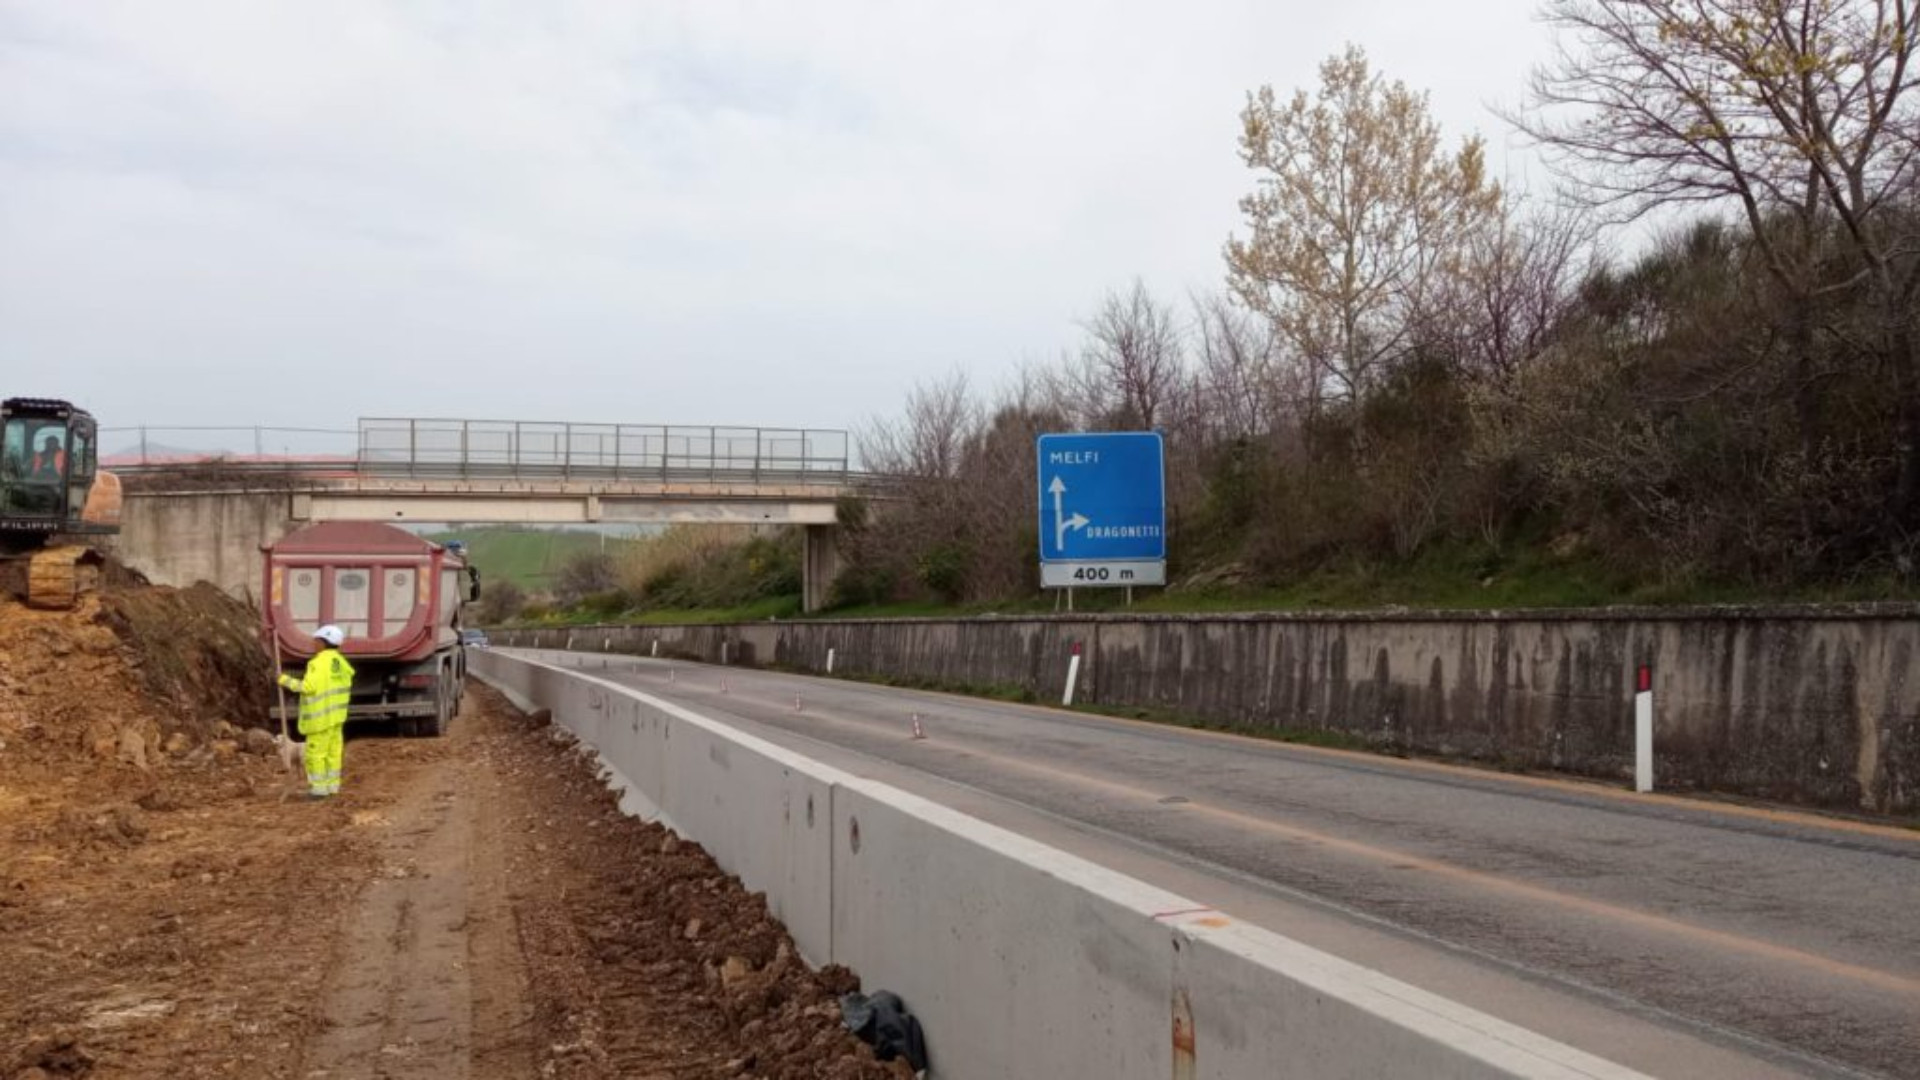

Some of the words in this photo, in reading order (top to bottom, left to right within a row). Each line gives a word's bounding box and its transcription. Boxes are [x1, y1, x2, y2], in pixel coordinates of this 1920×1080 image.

[1050, 451, 1098, 464] MELFI
[1086, 526, 1160, 538] DRAGONETTI
[1073, 567, 1109, 580] 400
[1120, 569, 1134, 580] m
